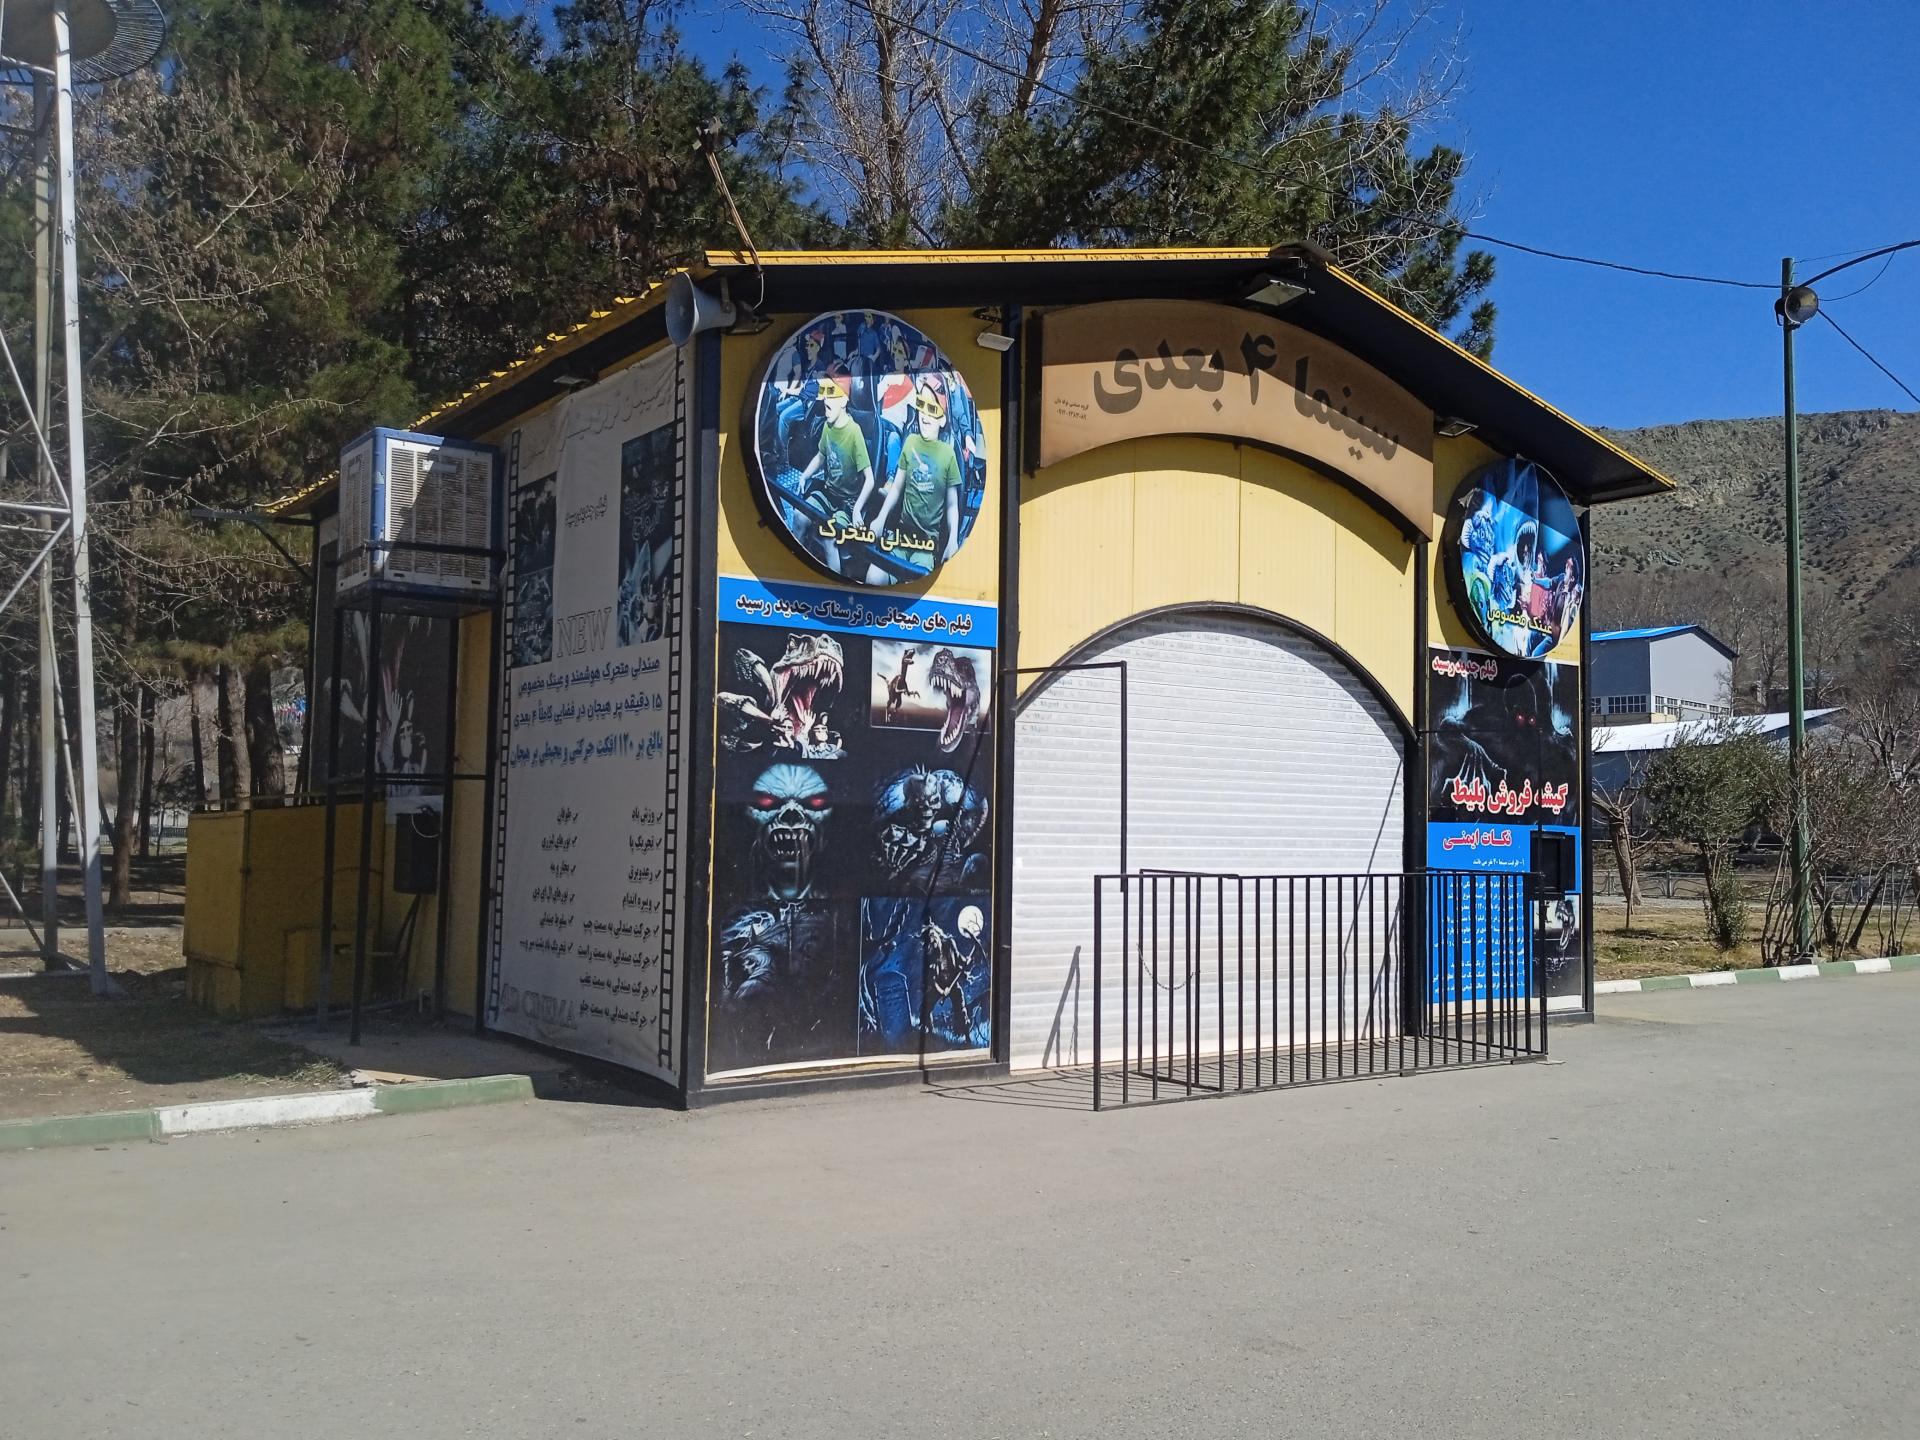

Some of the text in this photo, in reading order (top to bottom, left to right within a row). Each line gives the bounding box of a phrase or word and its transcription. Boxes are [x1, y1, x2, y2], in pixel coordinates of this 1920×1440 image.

[1093, 331, 1399, 461] سینما ۴ بعدی
[818, 519, 935, 551] صندلی متحرک
[736, 594, 973, 634] فیلم های هیجانی و ترسناک جدید رسید
[1487, 608, 1528, 628] مخصوص
[557, 607, 612, 658] NEW
[571, 666, 600, 687] هوشمند
[603, 661, 629, 683] متحرک
[631, 657, 660, 679] صندلی
[1432, 656, 1497, 680] فیلم جدید رسید
[518, 676, 545, 697] مخصوص
[546, 673, 564, 691] عینک
[554, 701, 575, 723] فضایی
[588, 698, 612, 720] هیجان
[614, 703, 623, 722] پر
[624, 692, 650, 715] دقیقه
[652, 694, 663, 710] ۱۵
[513, 713, 531, 729] بعدی
[576, 705, 586, 722] در
[596, 734, 617, 758] افکت
[646, 731, 663, 758] بالغ
[1451, 777, 1486, 812] بلیط
[1488, 778, 1533, 815] فروش
[1443, 828, 1512, 850] نکات ایمنی
[613, 919, 632, 938] صندلی
[613, 948, 632, 966] صندلی
[612, 977, 631, 995] صندلی
[610, 1006, 629, 1025] صندلی
